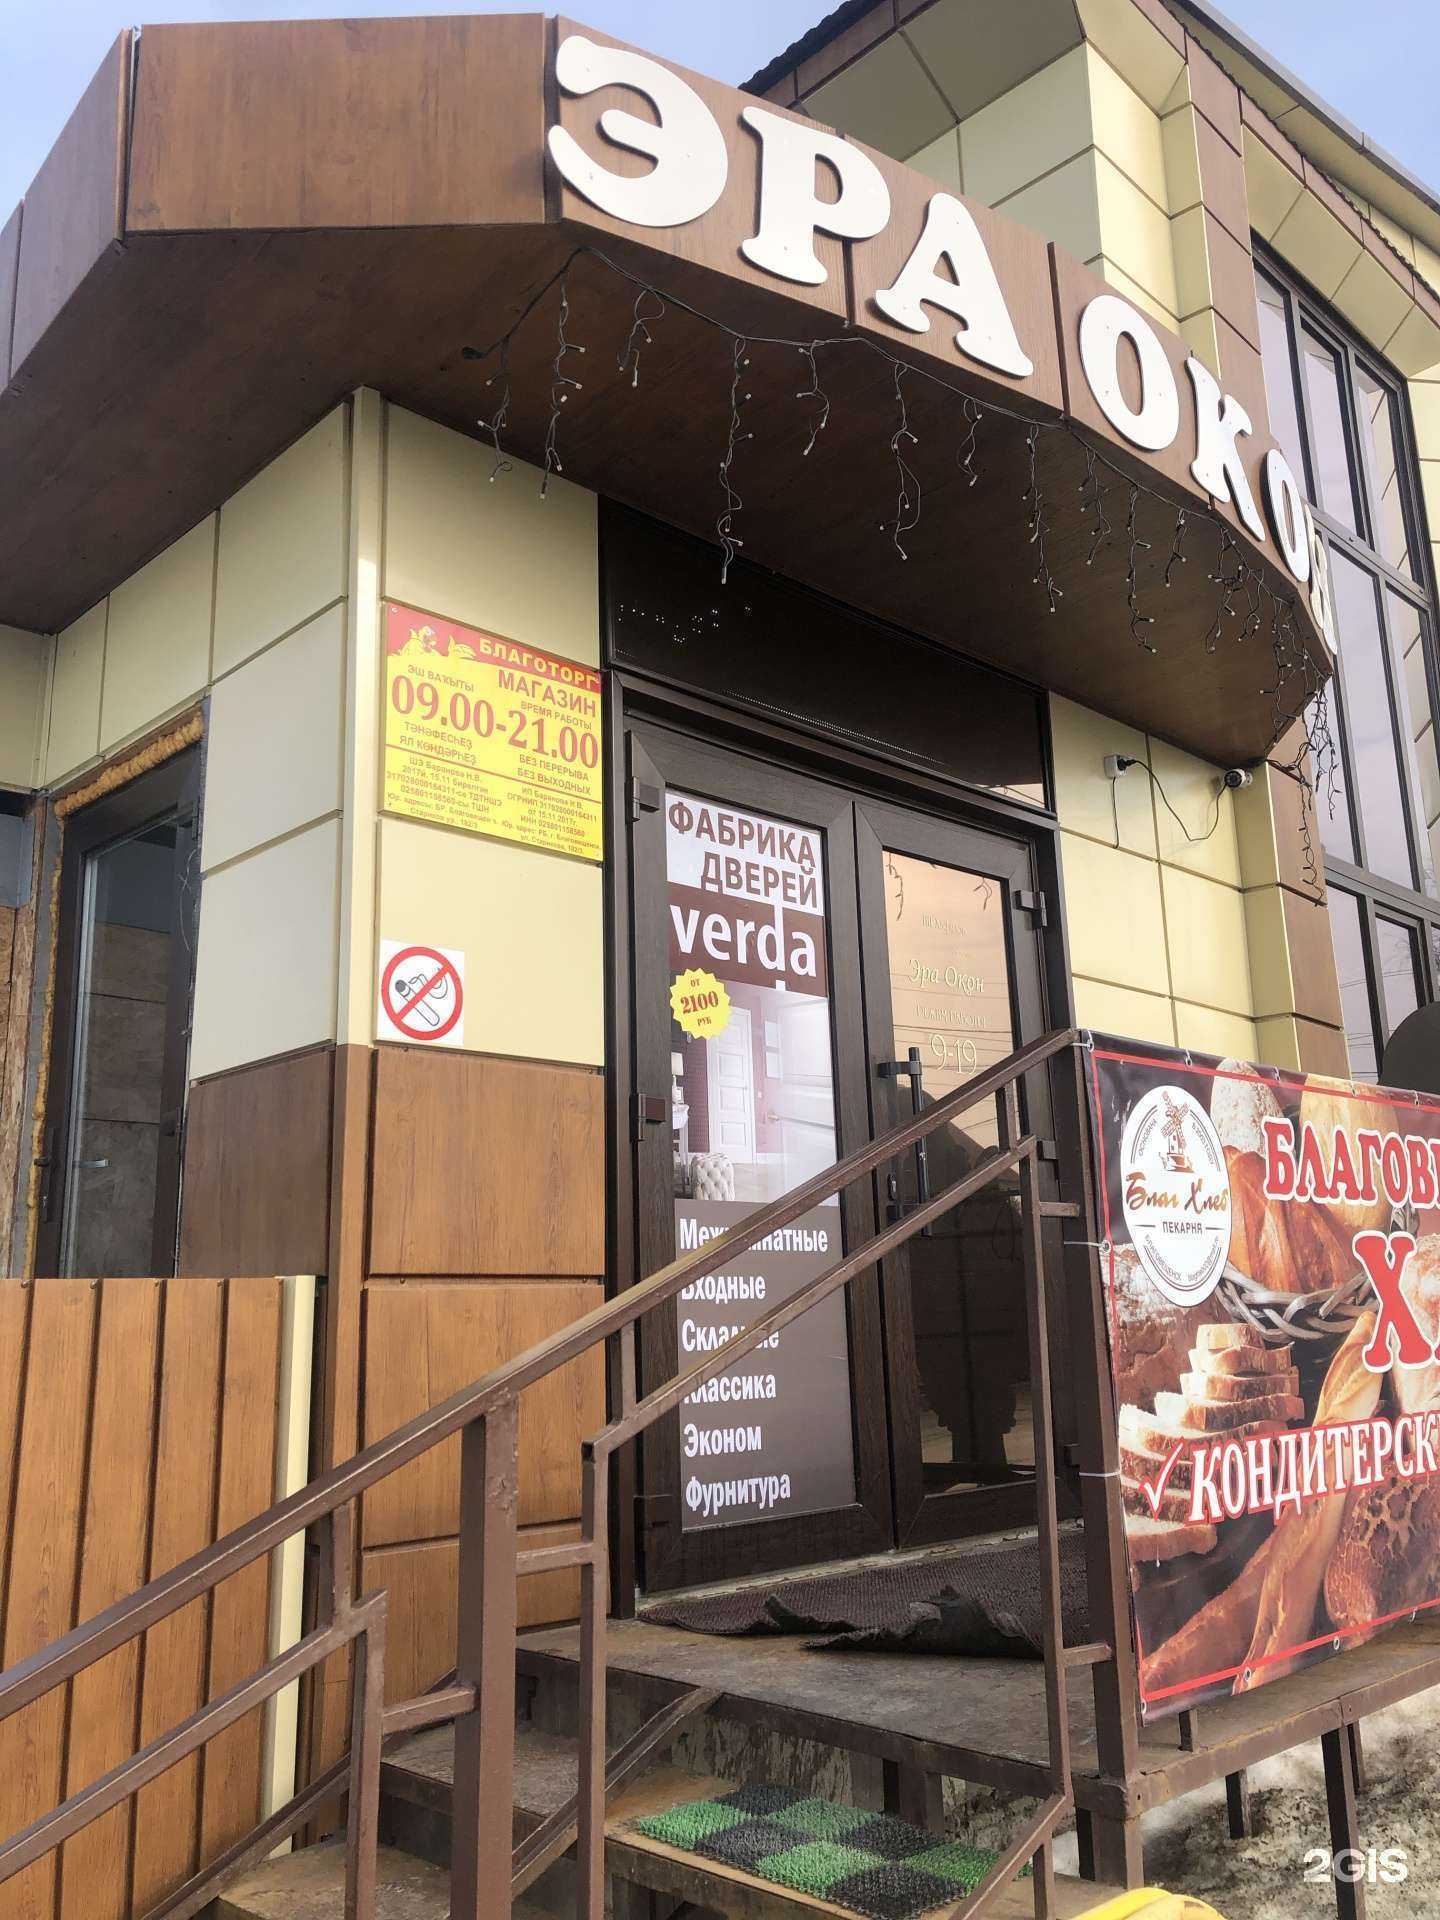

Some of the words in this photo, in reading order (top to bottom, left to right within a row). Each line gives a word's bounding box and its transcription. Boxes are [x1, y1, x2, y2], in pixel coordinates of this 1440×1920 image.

[548, 35, 1034, 377] ЭРА
[479, 637, 597, 690] БЛАГОТОРГ
[498, 669, 596, 718] МАГАЗИН
[520, 700, 553, 720] ВРЕМЯ
[554, 711, 592, 731] РАБОТЫ
[391, 674, 599, 769] 09.00-21.00
[517, 768, 536, 781] БЕЗ
[537, 772, 592, 796] ВЫХОДНЫХ
[519, 754, 538, 767] БЕЗ
[539, 760, 590, 782] ПЕРЕРЫВА
[668, 801, 817, 869] ФАБРИКА
[700, 850, 818, 909] ДВЕРЕЙ
[669, 903, 818, 977] verda
[908, 958, 940, 989] Эра
[945, 966, 986, 997] Окон
[680, 990, 719, 1014] 2100
[929, 1034, 977, 1075] 9-19
[1162, 1221, 1203, 1236] ПЕКАРНЯ
[1354, 1232, 1440, 1371] Х
[683, 1423, 763, 1458] Эконом
[1188, 1412, 1440, 1521] КОНДИТЕРСК
[684, 1472, 792, 1519] Фурнитура
